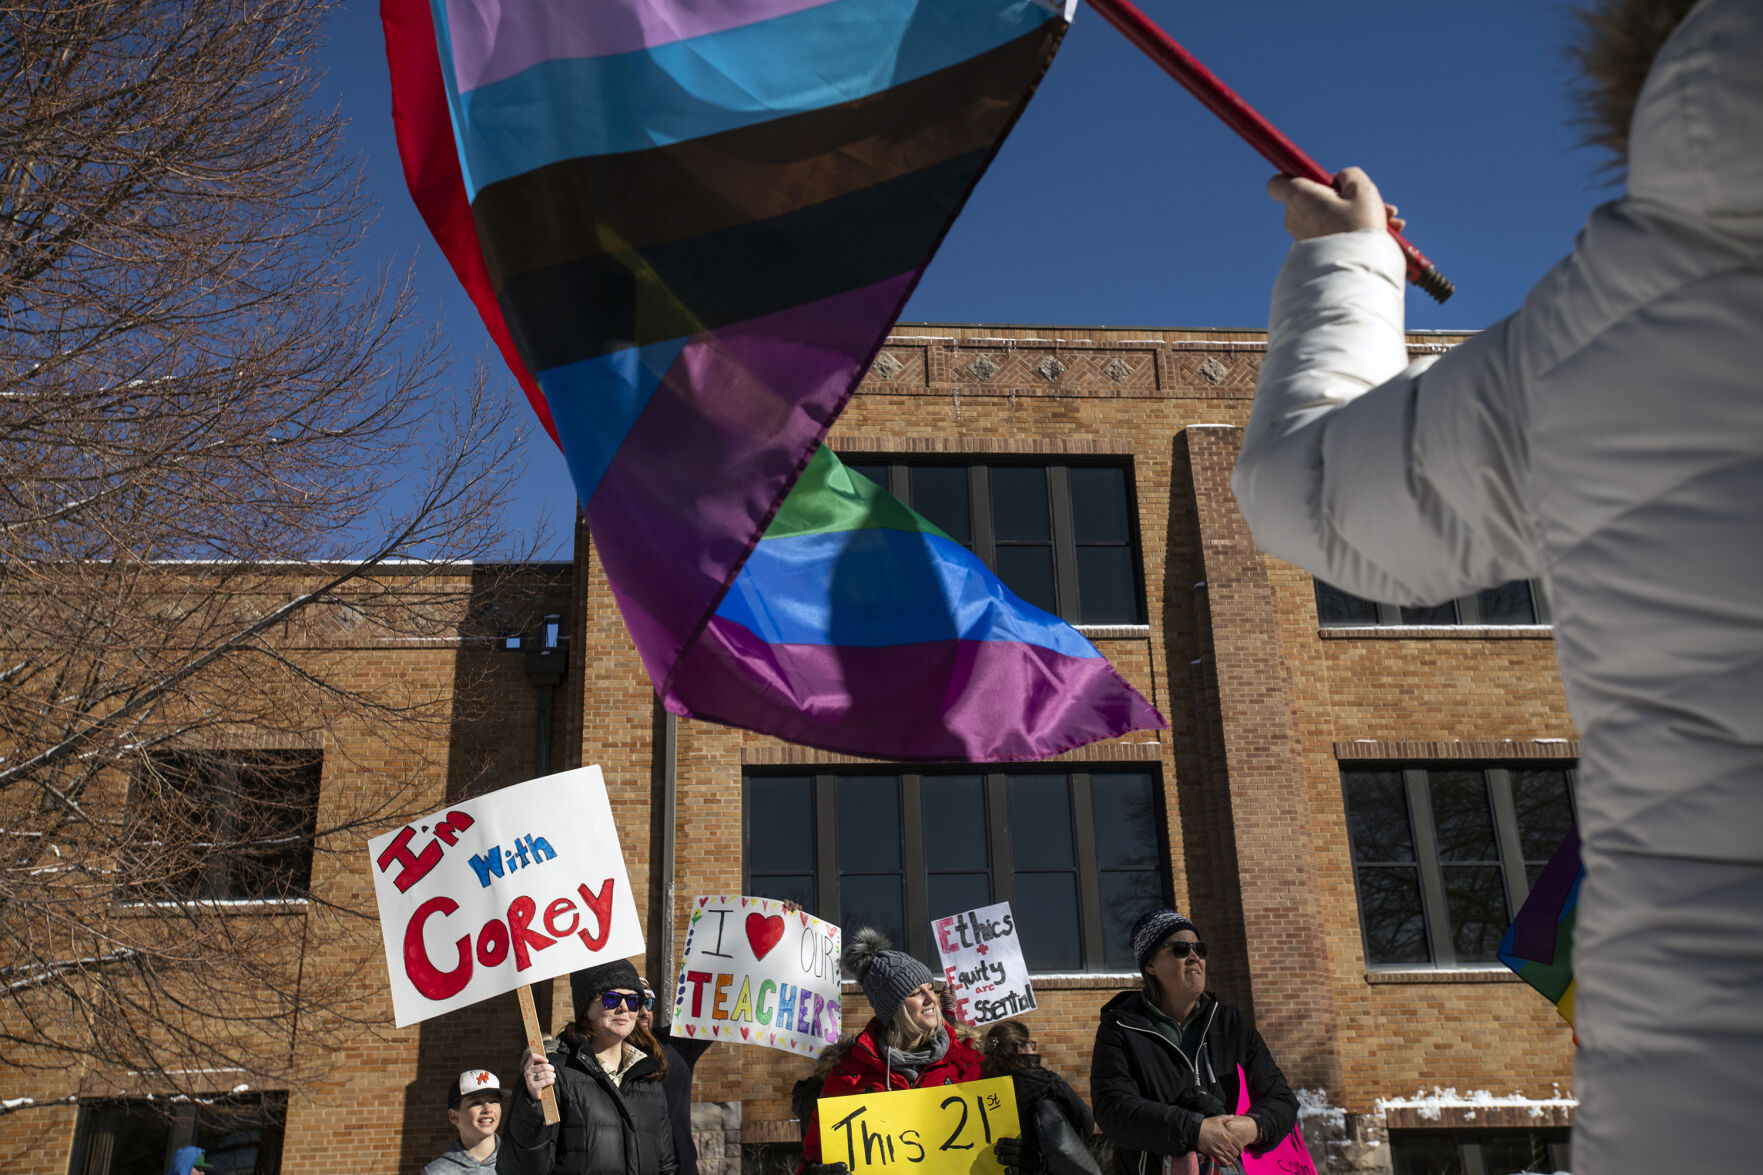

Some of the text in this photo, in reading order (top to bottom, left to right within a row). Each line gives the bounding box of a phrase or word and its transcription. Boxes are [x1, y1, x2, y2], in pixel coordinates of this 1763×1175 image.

[377, 810, 475, 894] I'm
[467, 833, 558, 888] With
[701, 909, 835, 985] I OUR
[935, 911, 1014, 955] Ethics
[945, 960, 1006, 990] Equity
[975, 983, 995, 994] are
[686, 970, 840, 1043] TEACHERS
[956, 984, 1037, 1027] Essential
[831, 1105, 925, 1172] This
